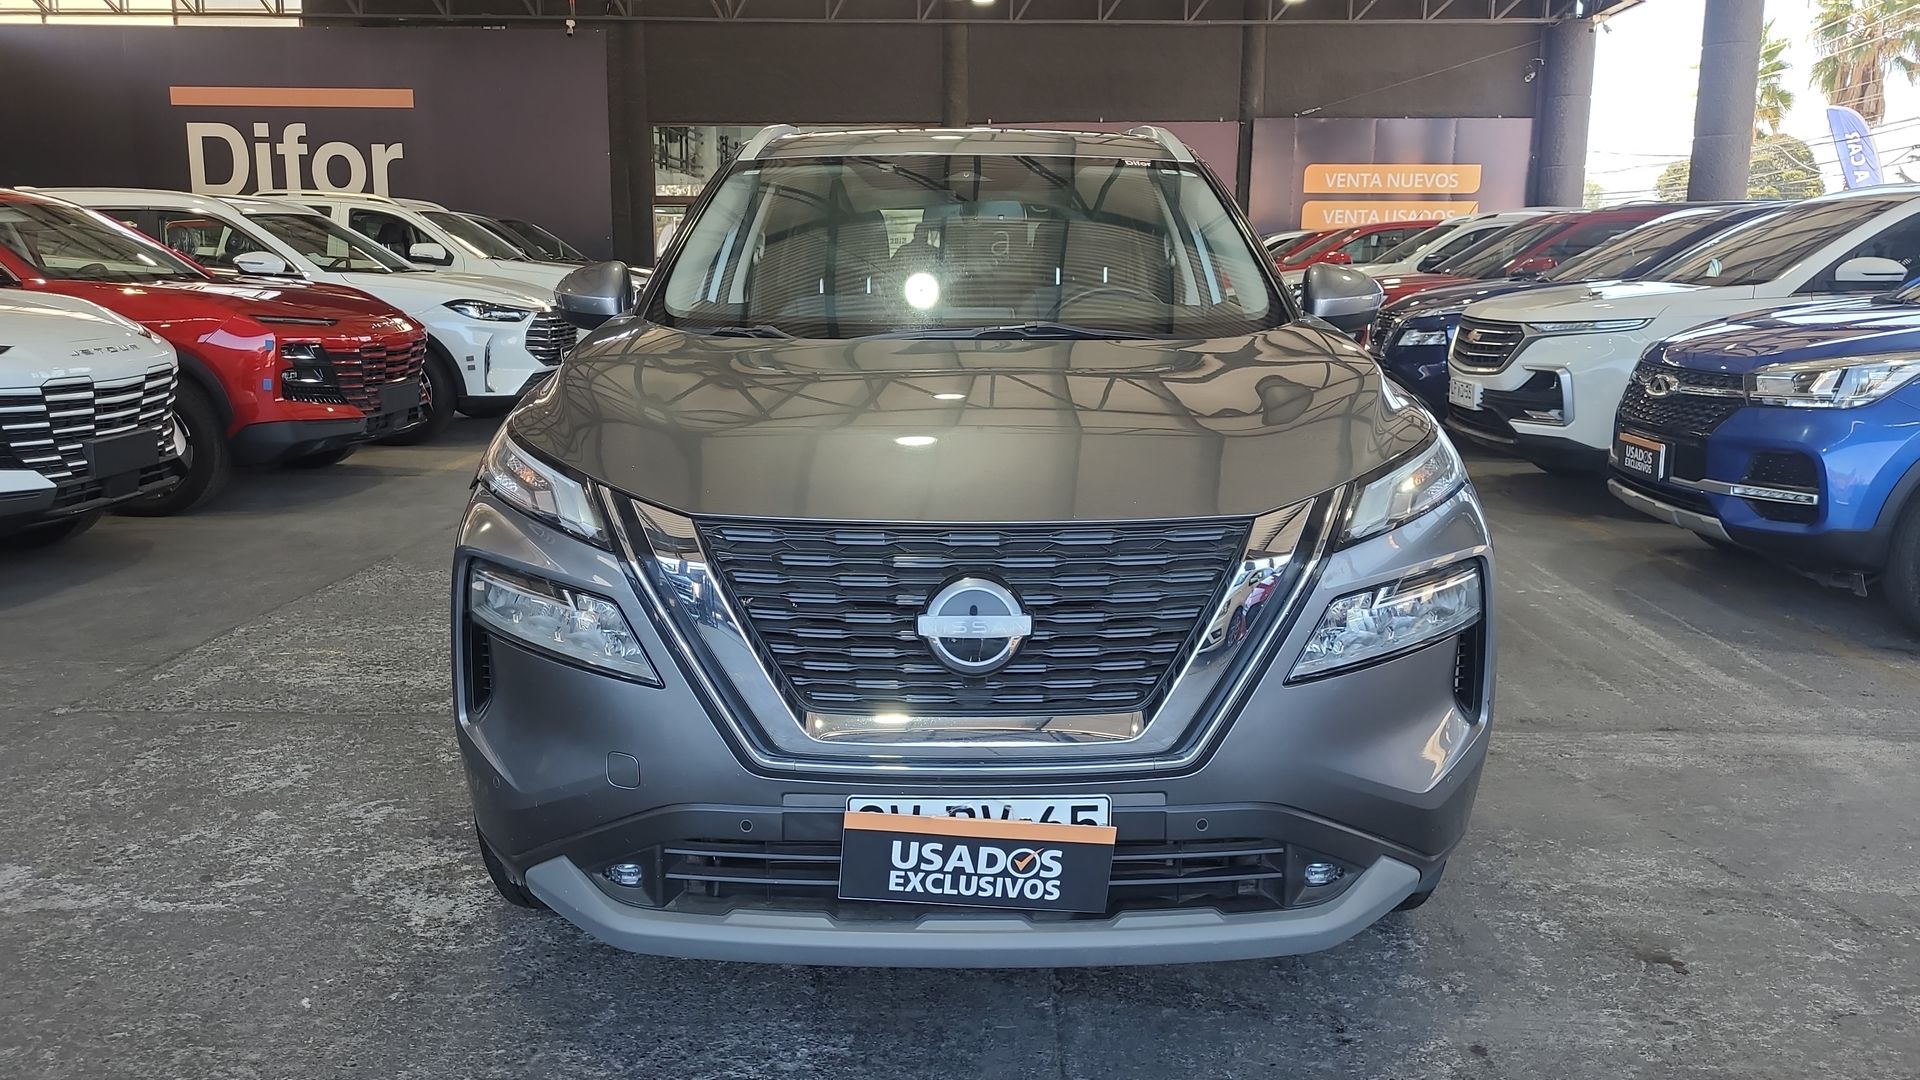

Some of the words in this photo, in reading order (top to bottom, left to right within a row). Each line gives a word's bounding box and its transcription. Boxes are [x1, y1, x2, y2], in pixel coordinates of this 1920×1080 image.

[186, 122, 404, 198] Difor
[1325, 172, 1383, 188] VENTA
[1386, 172, 1460, 188] NUEVOS
[1322, 209, 1380, 225] VENTA
[1625, 444, 1653, 465] USADOS
[1624, 457, 1652, 474] EXCLUSIVOS
[891, 840, 1063, 878] USADOS
[888, 870, 1061, 900] EXCLUSIVOS
